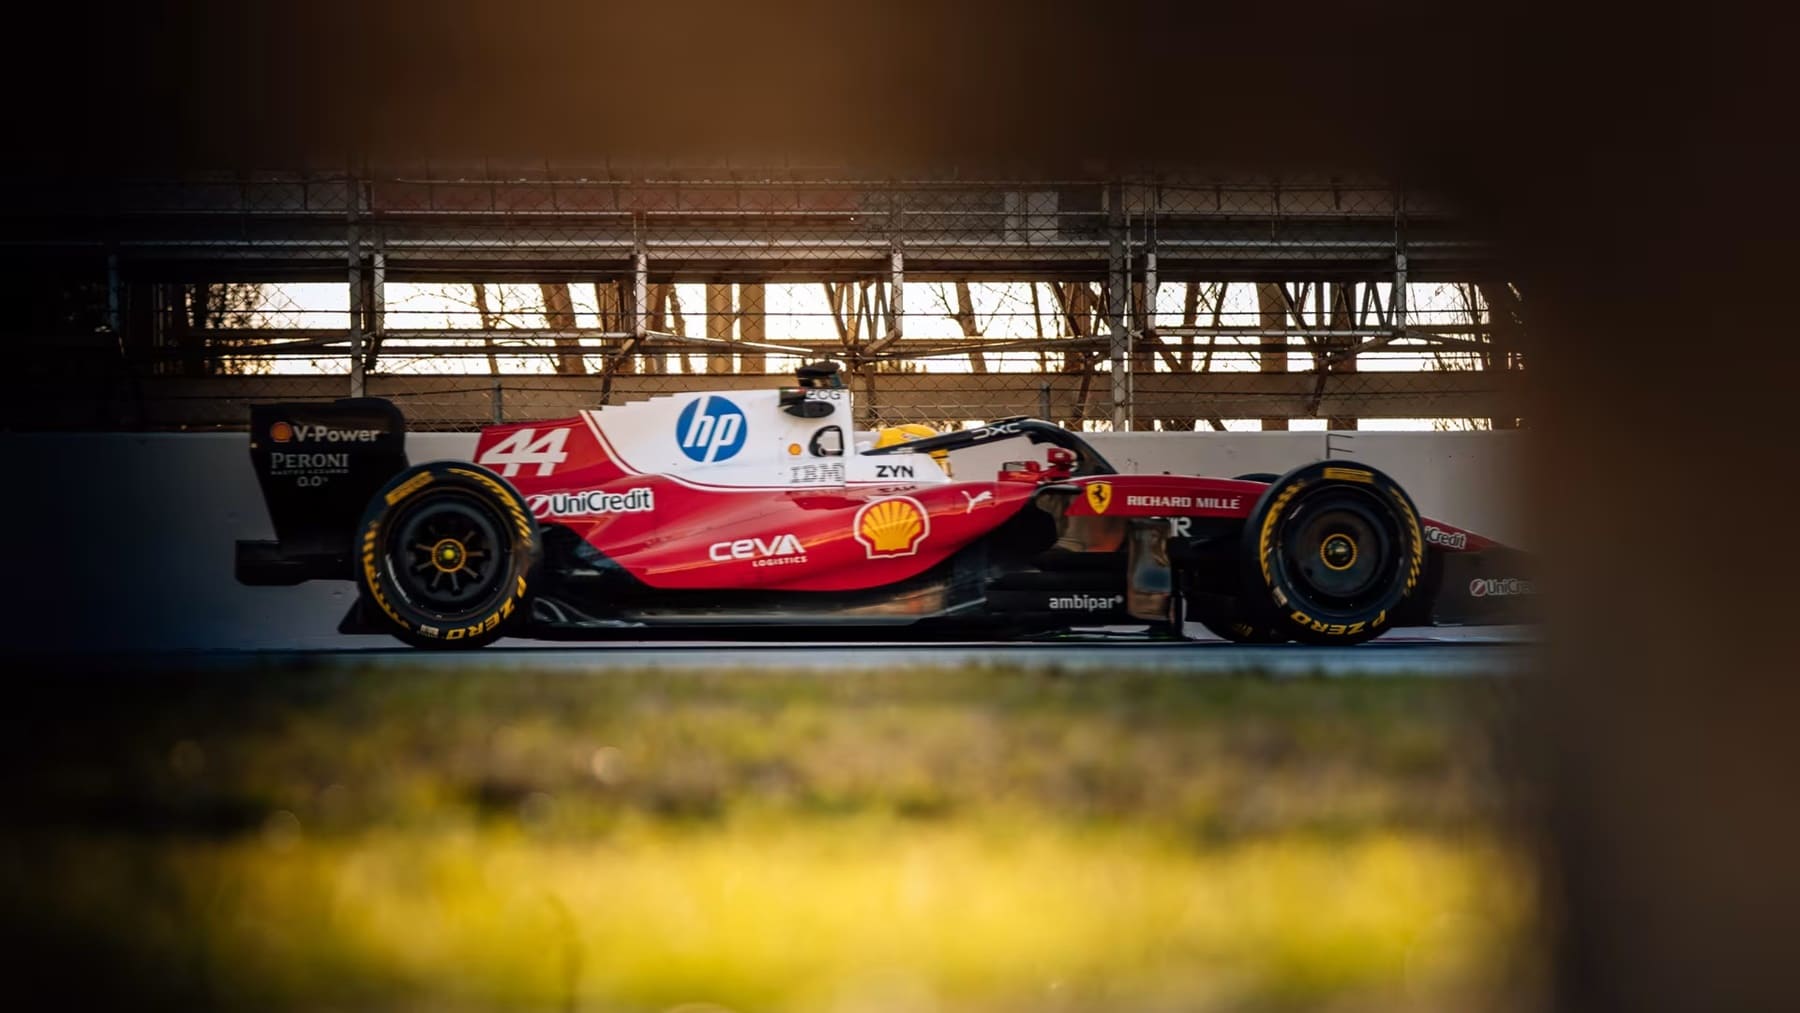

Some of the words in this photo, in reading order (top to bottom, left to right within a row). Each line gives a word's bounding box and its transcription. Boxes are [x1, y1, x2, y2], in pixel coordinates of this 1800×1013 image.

[294, 425, 379, 442] V-Power
[682, 396, 744, 463] hp
[271, 452, 349, 468] PERONI
[479, 428, 571, 477] 44
[790, 463, 844, 483] IBM
[876, 465, 914, 478] ZYN
[553, 491, 651, 514] UniCredit
[1126, 495, 1191, 508] RICHARD
[752, 556, 808, 567] LOGISTICS
[1048, 594, 1116, 612] ambipar
[1290, 610, 1366, 635] ZERO
